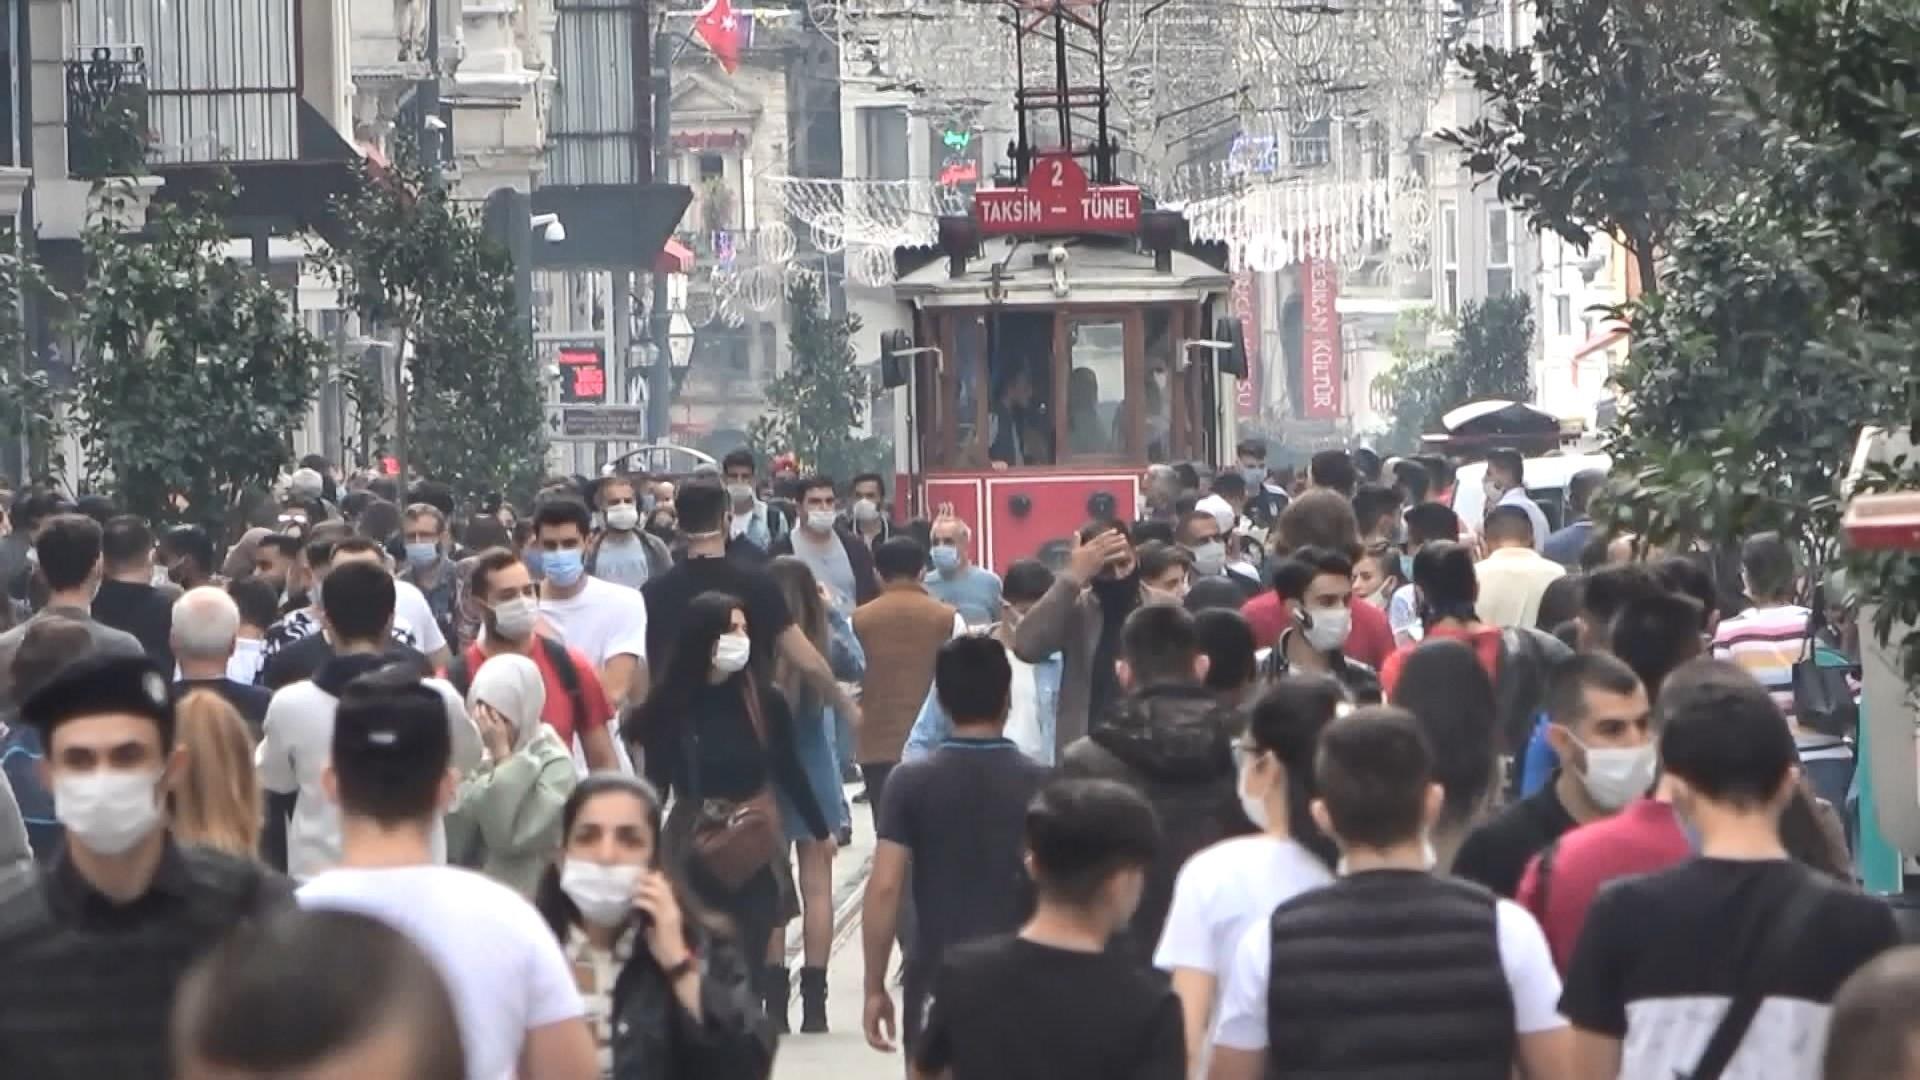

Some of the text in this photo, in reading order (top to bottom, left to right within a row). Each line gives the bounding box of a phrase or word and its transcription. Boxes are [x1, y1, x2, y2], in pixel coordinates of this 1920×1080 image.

[1051, 160, 1063, 187] 2
[981, 194, 1041, 222] TAKSİM
[1081, 193, 1134, 220] TÜNEL
[1311, 339, 1334, 408] KÜLTÜR
